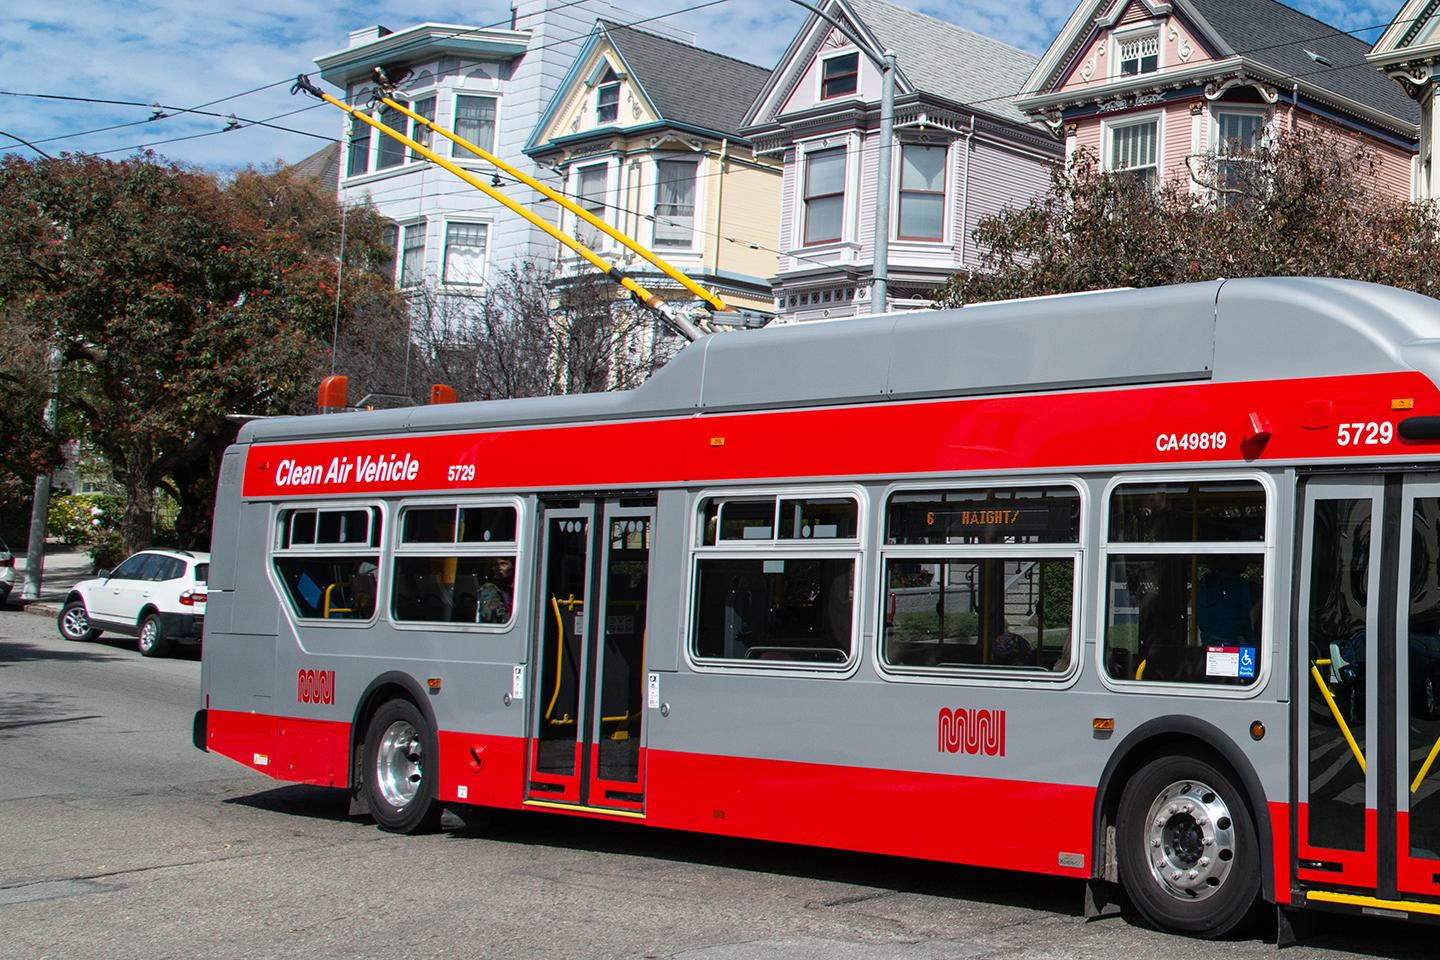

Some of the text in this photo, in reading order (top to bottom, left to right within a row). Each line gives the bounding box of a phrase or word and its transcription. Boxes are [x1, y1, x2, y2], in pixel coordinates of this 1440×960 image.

[1156, 431, 1227, 452] CA49819
[1338, 422, 1394, 447] 5729
[275, 453, 420, 486] Clean Air Vehicle
[447, 464, 476, 481] 5729
[926, 511, 935, 526] 6
